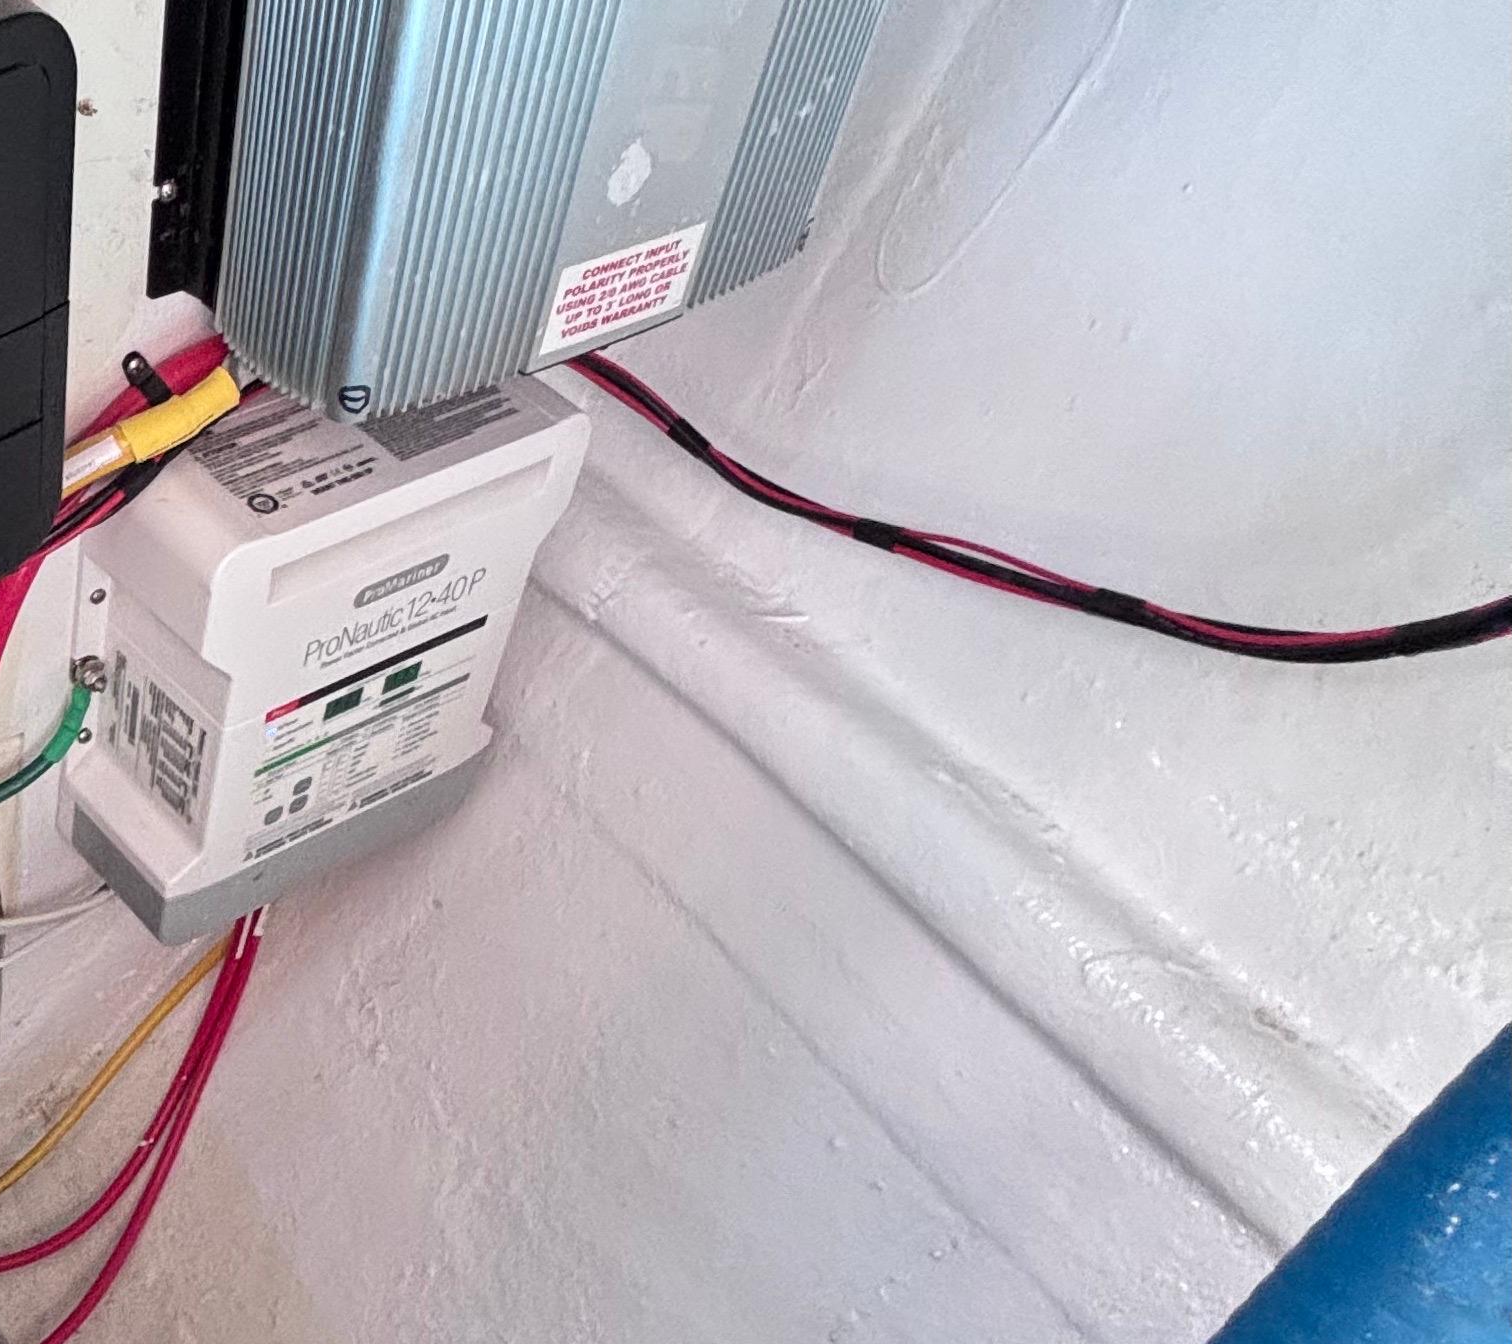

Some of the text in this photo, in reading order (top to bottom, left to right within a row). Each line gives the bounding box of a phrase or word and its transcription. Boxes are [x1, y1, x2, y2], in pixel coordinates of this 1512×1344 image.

[563, 249, 690, 300] POLARITY PROPERLY
[582, 239, 682, 280] CONNECT INPUT
[556, 292, 595, 315] USING
[619, 277, 647, 294] AWG
[649, 262, 689, 284] CABLE
[565, 310, 583, 325] UP
[585, 304, 602, 318] TO
[618, 289, 652, 308] LONG
[654, 281, 671, 295] OR
[560, 296, 668, 339] VOIDS WARRANTY
[361, 561, 441, 604] ProMariner
[303, 606, 404, 666] ProNautic
